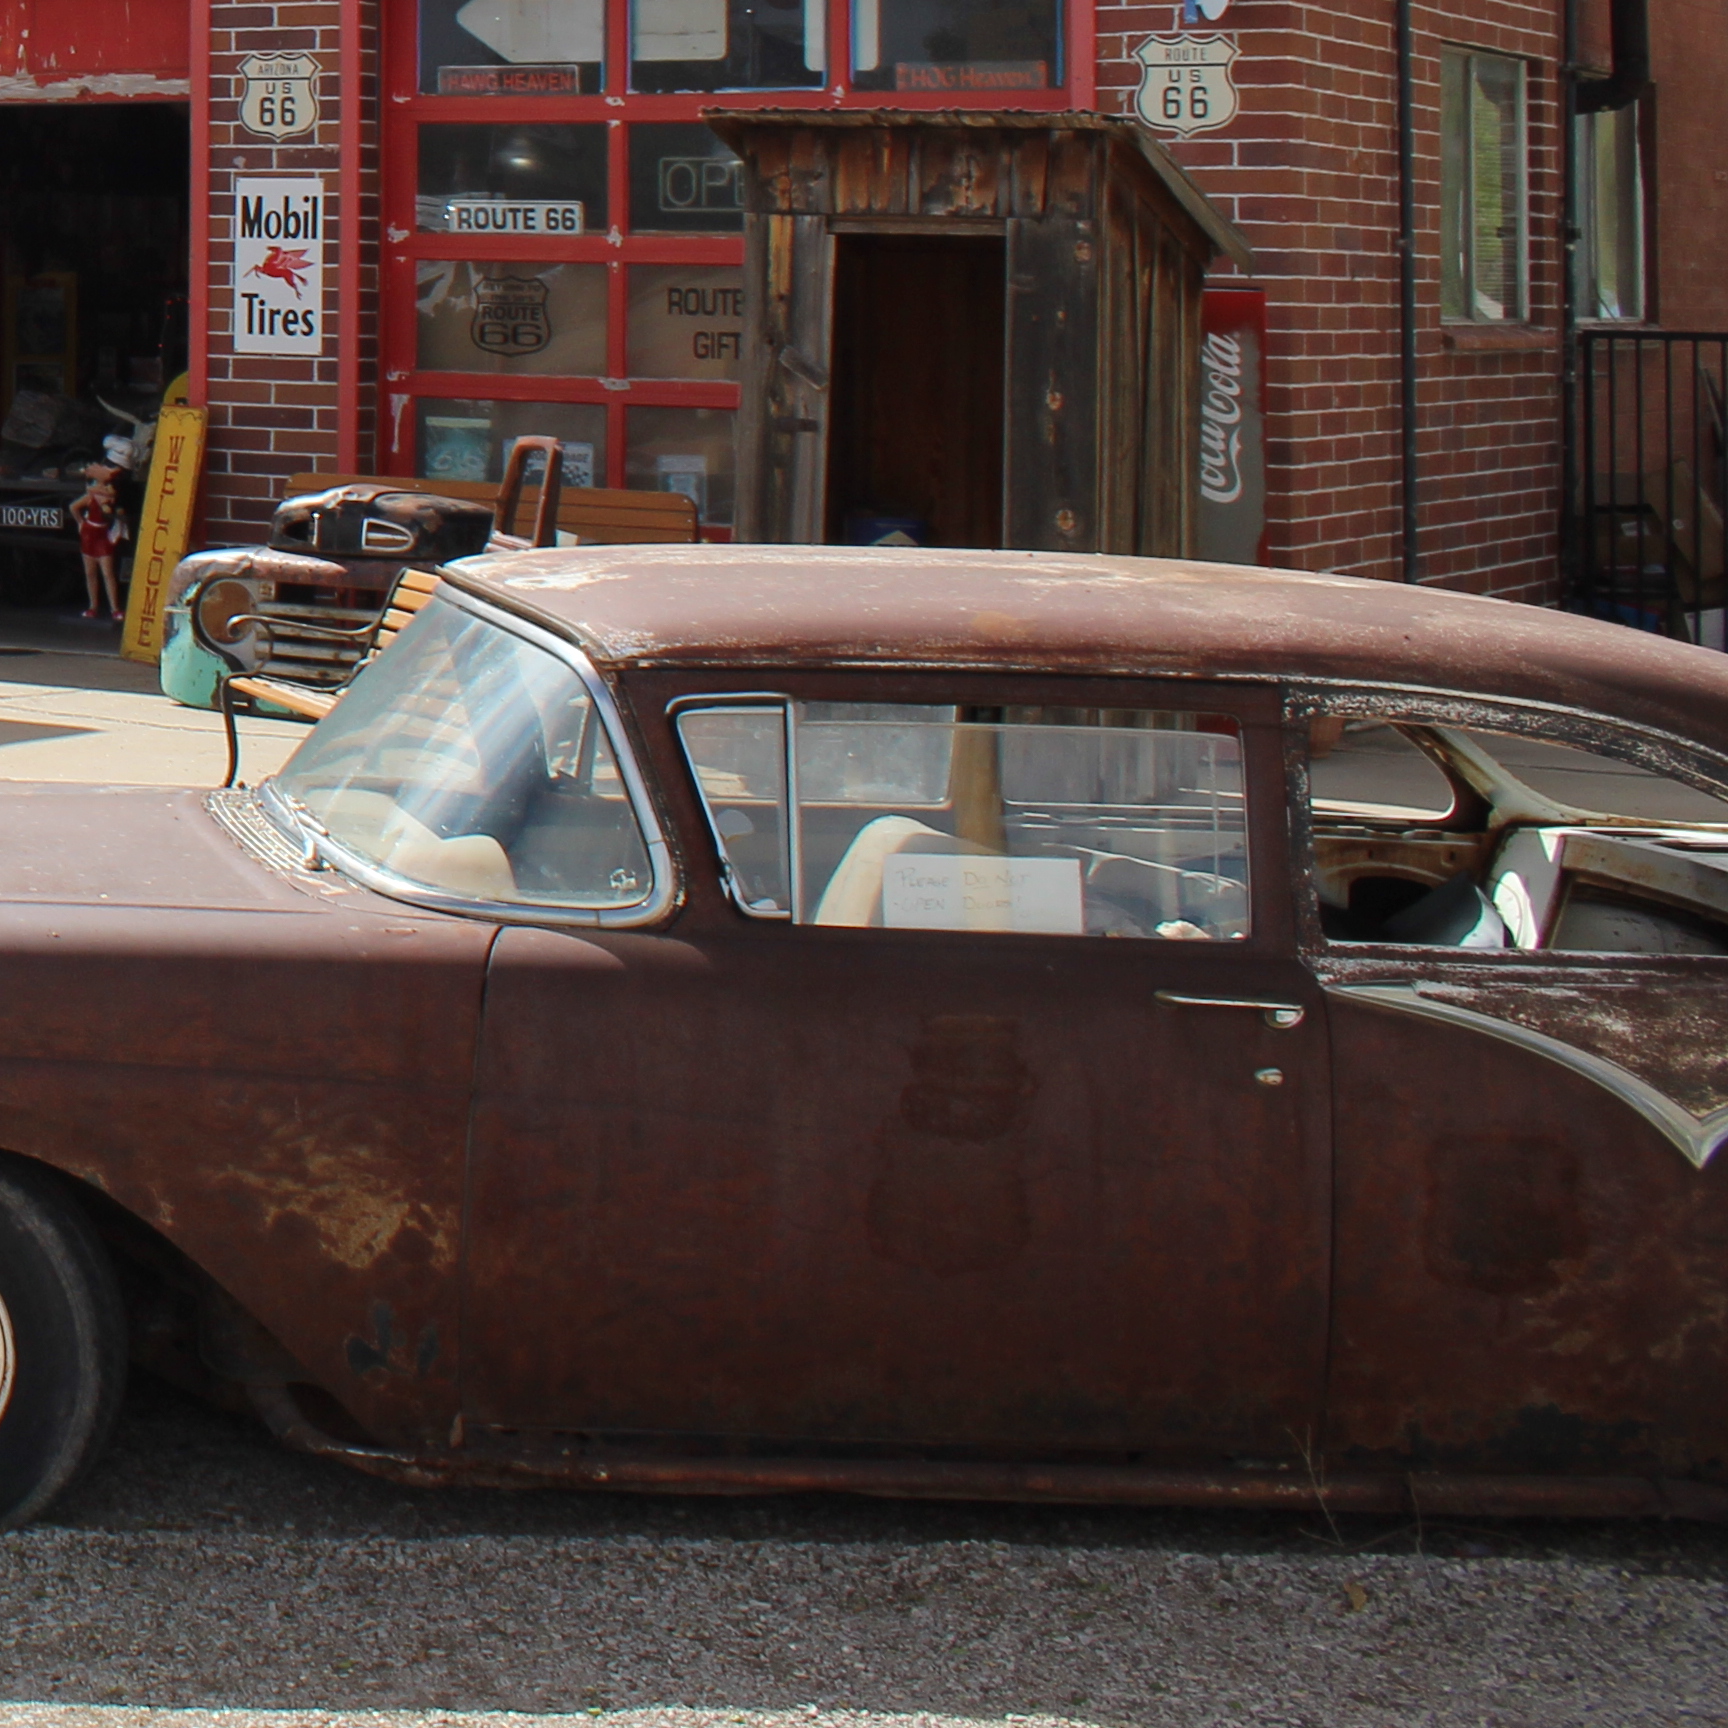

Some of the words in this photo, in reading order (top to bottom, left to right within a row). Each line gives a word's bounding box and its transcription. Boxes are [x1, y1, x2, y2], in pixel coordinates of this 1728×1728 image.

[1164, 47, 1208, 61] ROUTE
[258, 63, 299, 75] ARIZONA
[503, 73, 573, 91] HEAVEN
[259, 97, 295, 126] 66
[1163, 86, 1208, 119] 66
[667, 161, 744, 207] OP
[241, 195, 318, 240] Mobil
[457, 207, 535, 230] ROUTE
[545, 207, 576, 231] 66
[241, 293, 315, 337] Tires
[482, 306, 540, 321] ROUTE
[667, 287, 744, 317] ROUTE
[479, 322, 543, 347] 66
[693, 330, 742, 360] GIFT
[137, 435, 186, 647] WELCOME
